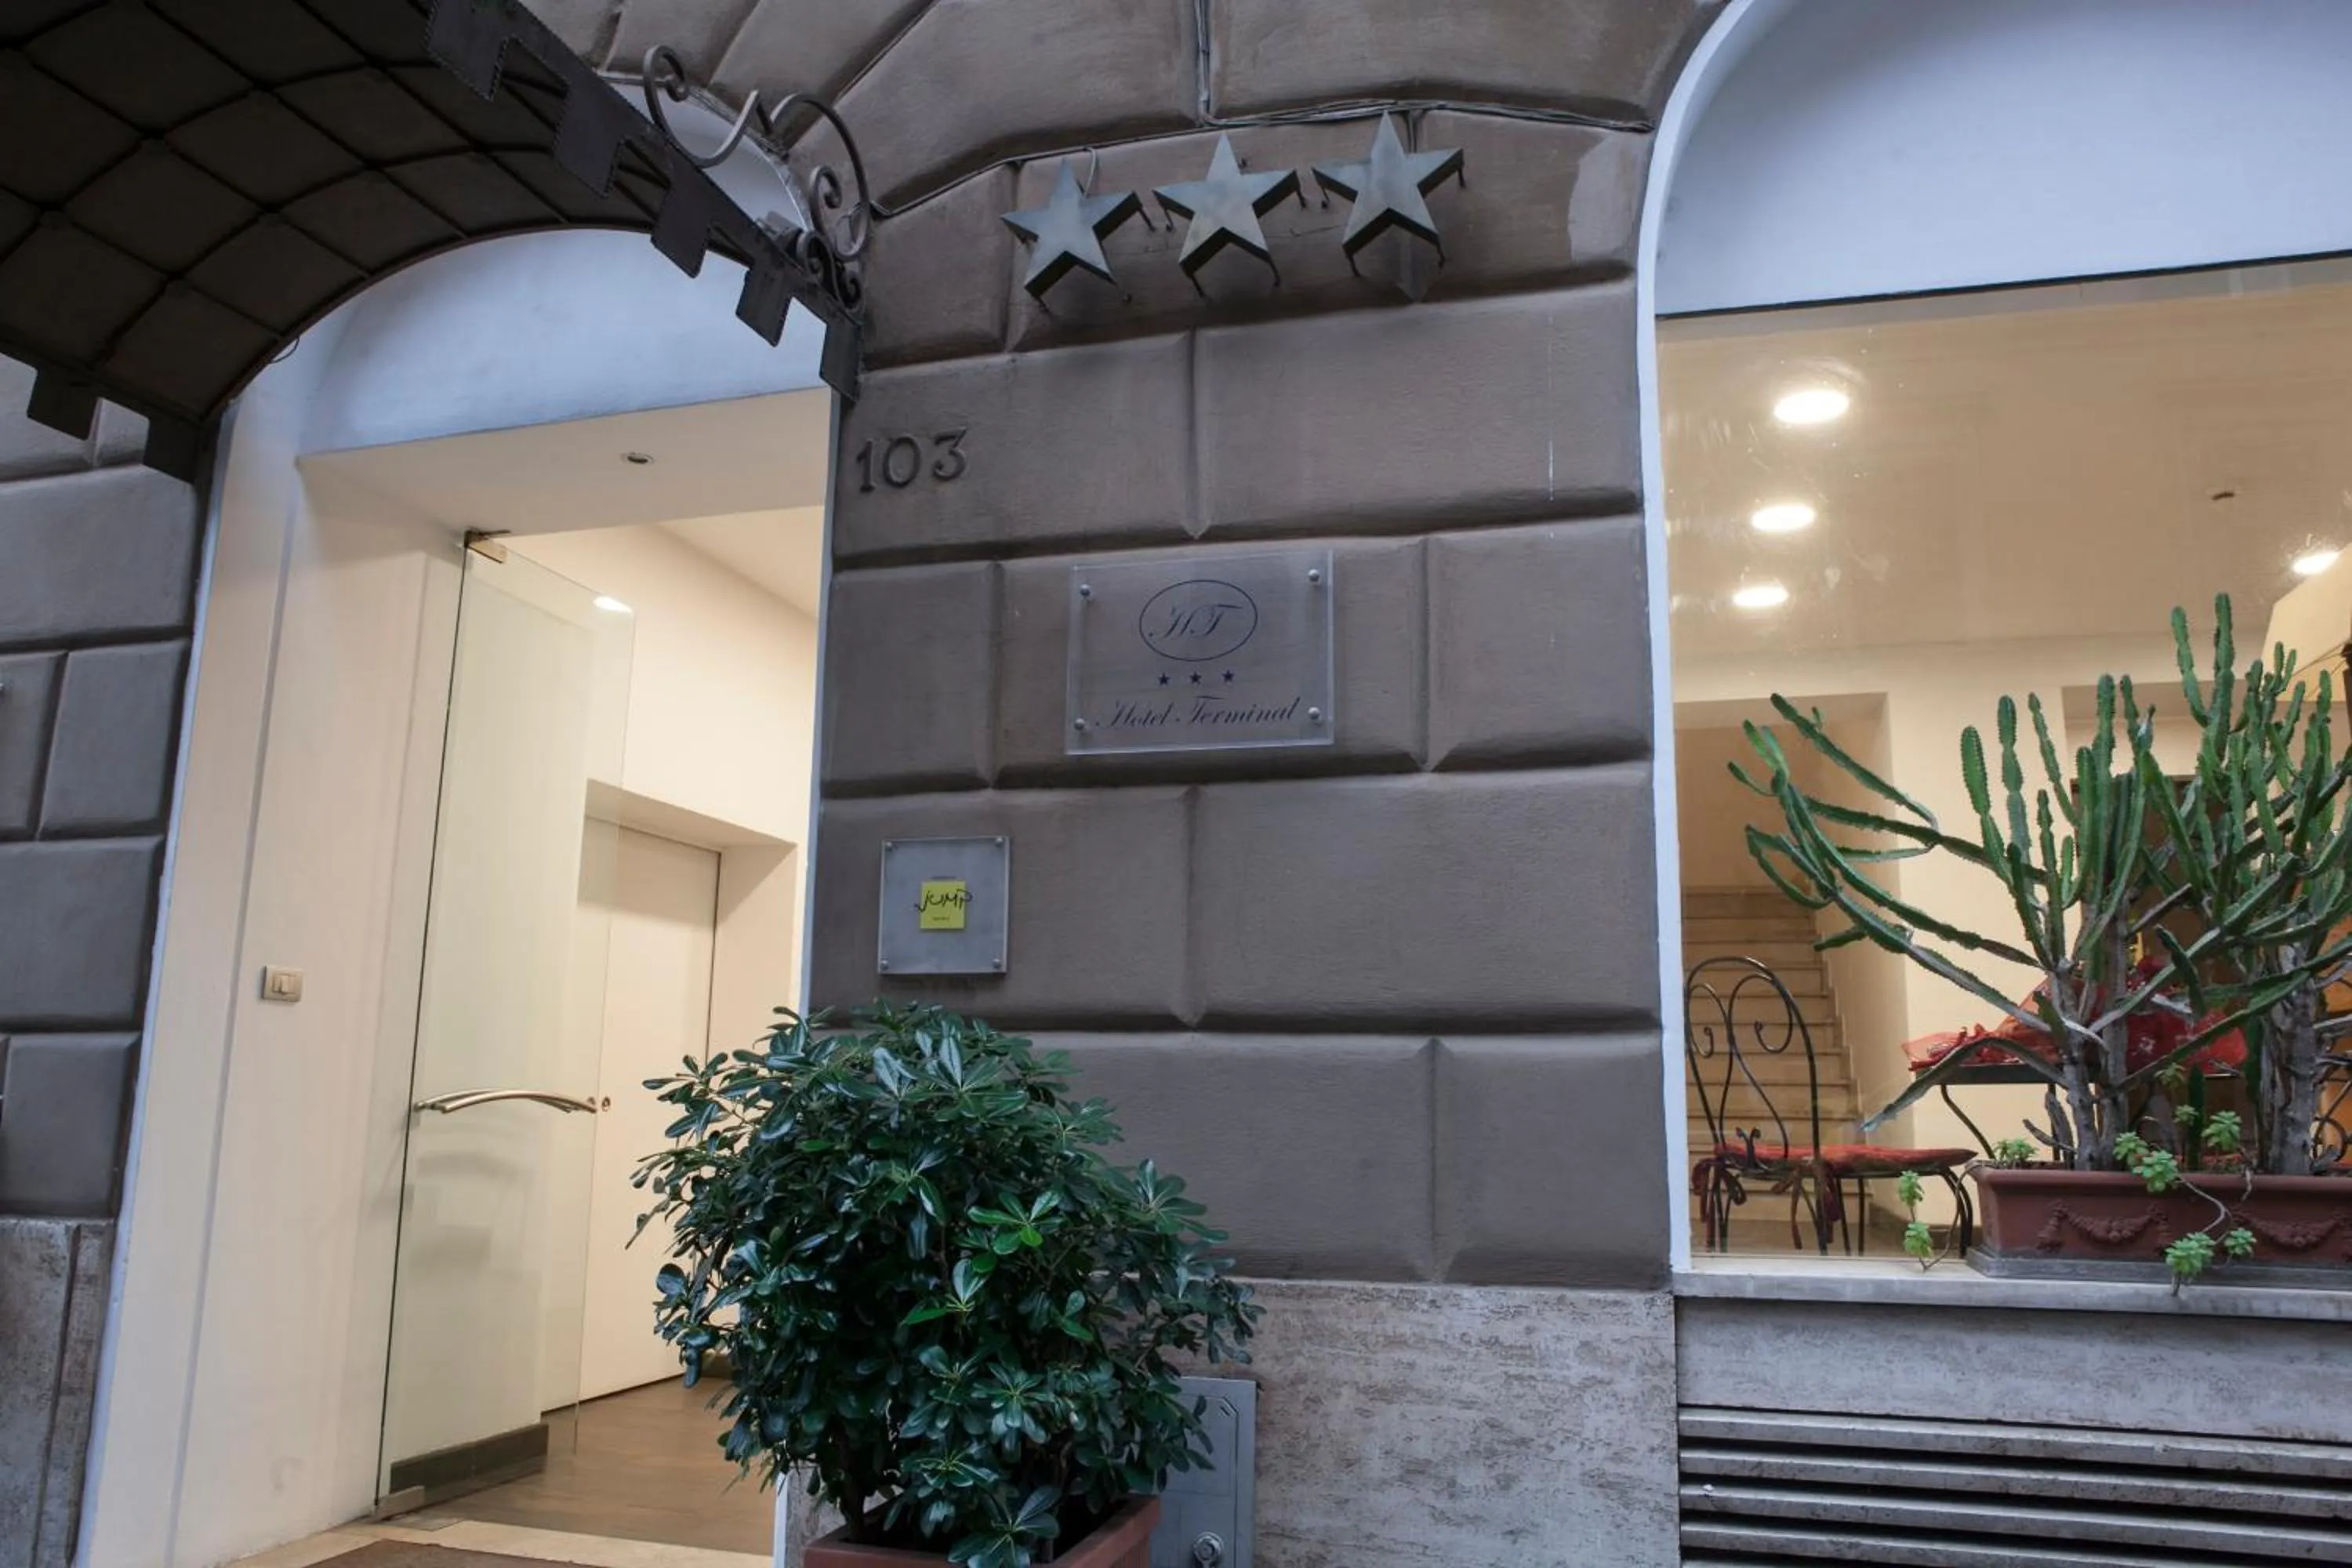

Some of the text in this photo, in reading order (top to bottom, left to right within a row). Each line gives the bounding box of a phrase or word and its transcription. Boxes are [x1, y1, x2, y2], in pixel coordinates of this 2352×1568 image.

[855, 426, 967, 493] 103
[1096, 695, 1301, 728] Hotel Terminal
